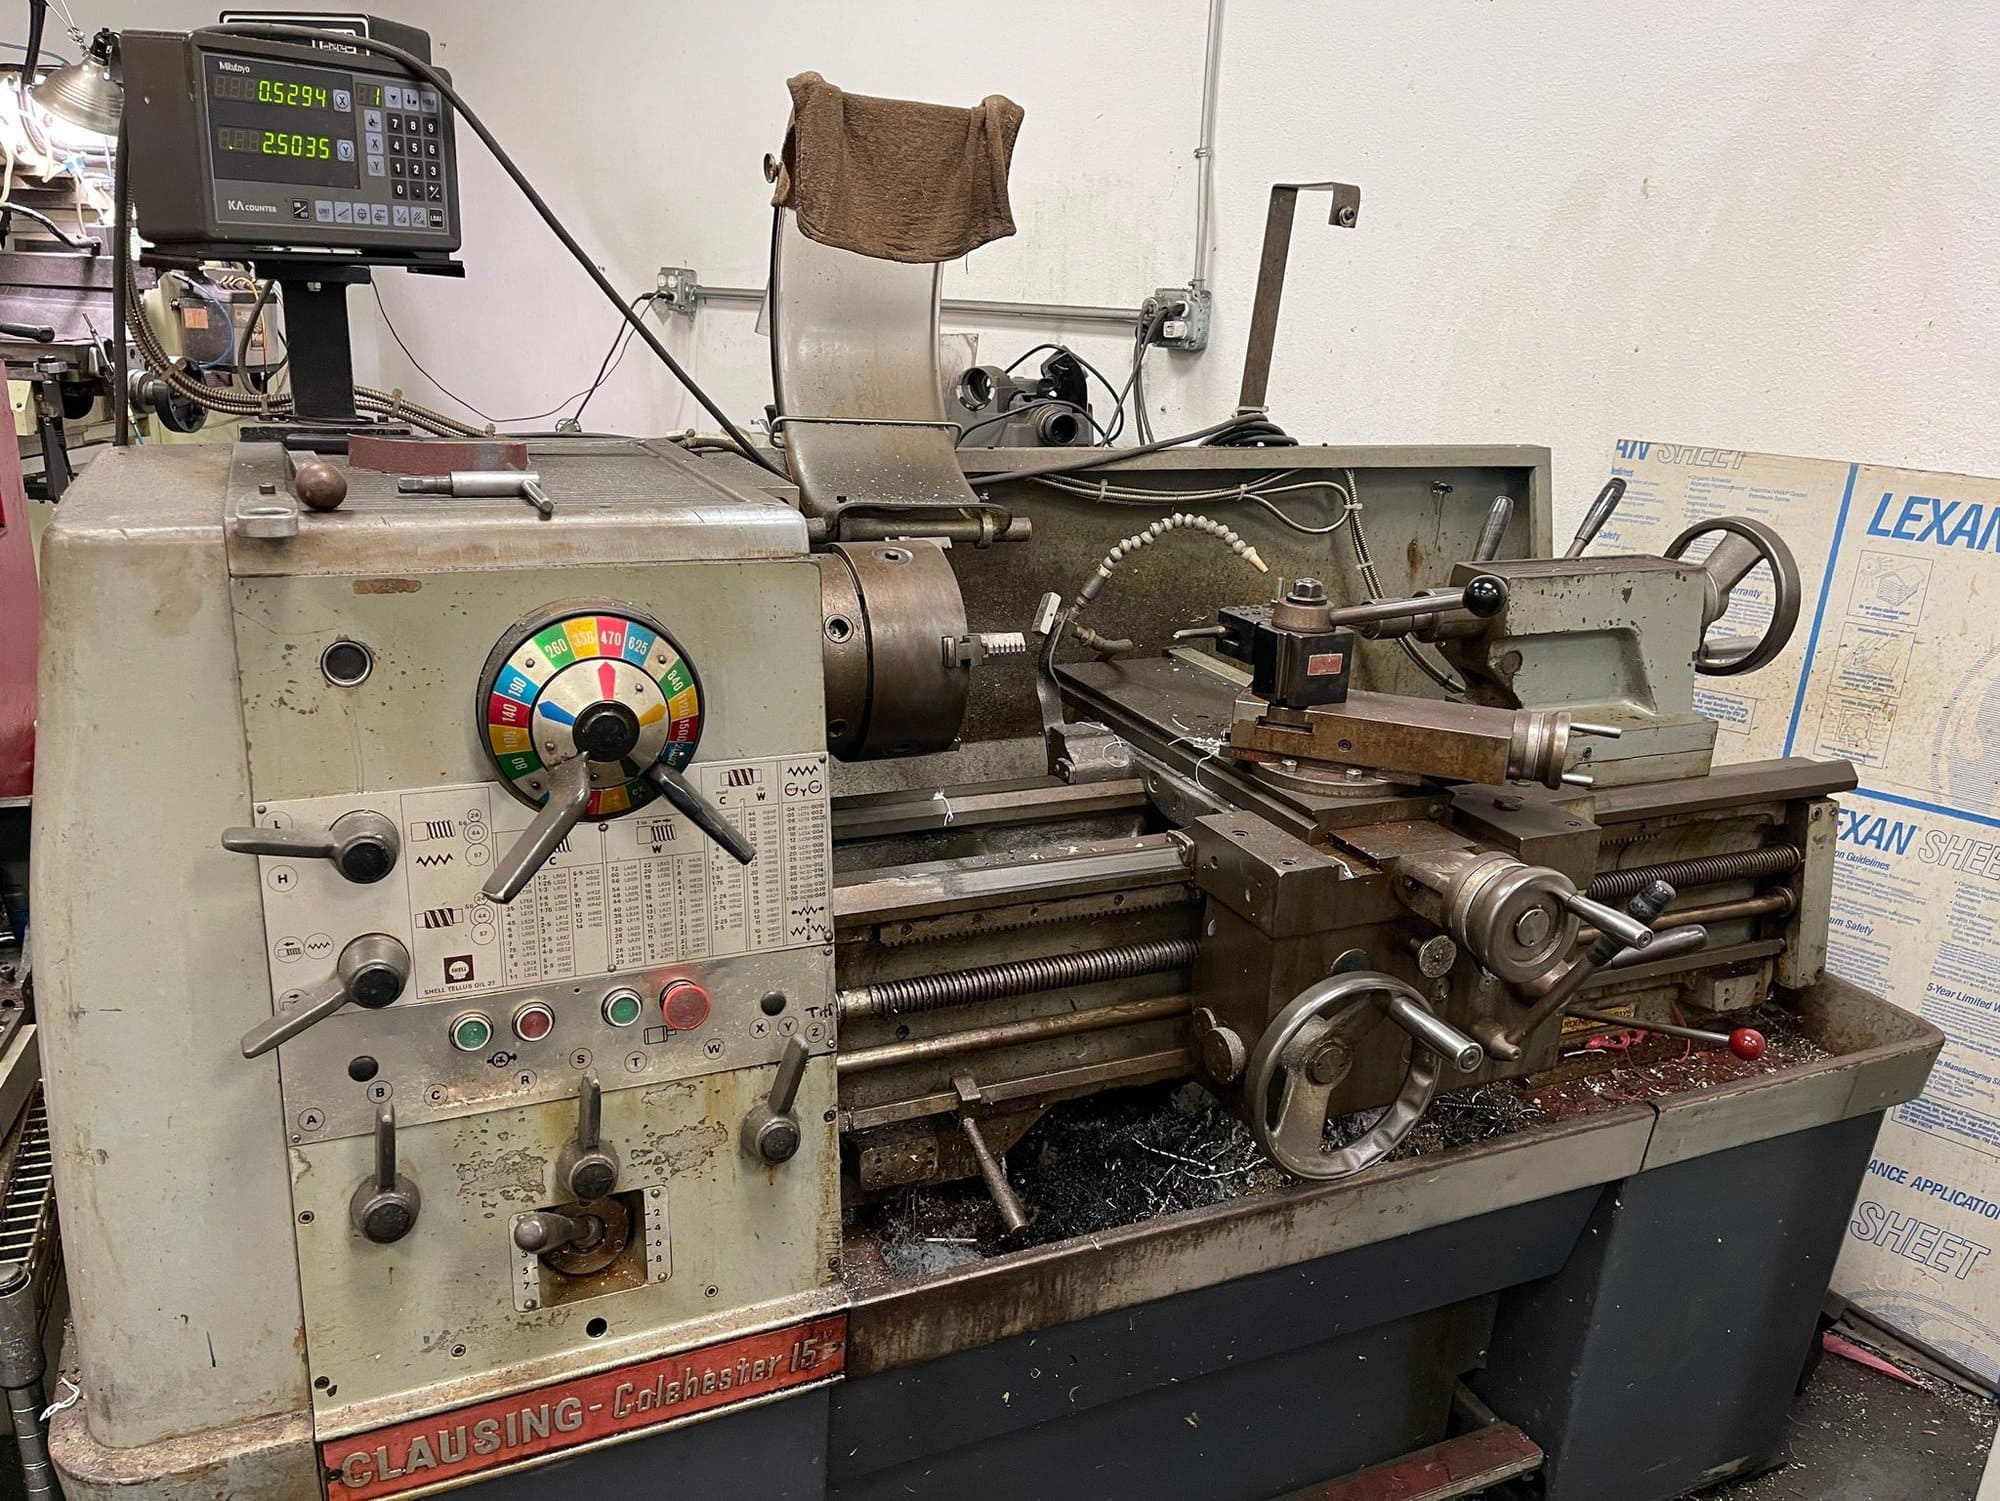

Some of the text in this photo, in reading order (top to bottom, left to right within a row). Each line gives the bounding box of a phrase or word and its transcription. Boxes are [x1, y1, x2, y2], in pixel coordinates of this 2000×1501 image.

[259, 80, 326, 107] 0.5294
[376, 88, 380, 105] 1
[392, 118, 398, 129] 7
[410, 121, 416, 131] 8
[428, 123, 434, 133] 9
[262, 132, 329, 158] 2.5035
[372, 138, 378, 148] X
[393, 141, 399, 150] 4
[412, 143, 418, 153] 5
[429, 145, 435, 155] 6
[373, 161, 379, 171] Y
[413, 165, 419, 175] 2
[430, 166, 436, 176] 3
[397, 185, 403, 194] 0
[228, 201, 277, 214] KA COUNTER
[1731, 587, 1762, 599] arranty
[600, 630, 622, 646] 470
[545, 639, 568, 658] 260
[628, 636, 649, 655] 625
[667, 670, 684, 692] 840
[508, 677, 527, 697] 190
[502, 703, 517, 722] 140
[512, 757, 528, 770] 80
[756, 792, 765, 801] W
[800, 788, 807, 796] Y
[719, 796, 726, 804] C
[274, 820, 281, 829] L
[652, 845, 662, 853] W
[1837, 808, 2000, 881] EXAN SHEE
[549, 857, 557, 865] C
[1846, 851, 1891, 871] Guidelines
[277, 874, 288, 884] H
[1845, 919, 1874, 936] Safety
[448, 984, 473, 992] TELLUS
[1926, 982, 1956, 998] 5-Year
[1956, 991, 1993, 1010] Limited
[756, 1024, 765, 1033] X
[784, 1022, 793, 1031] Y
[812, 1028, 819, 1037] Z
[707, 1045, 721, 1054] W
[576, 1054, 585, 1064] S
[632, 1057, 640, 1067] T
[520, 1075, 530, 1085] R
[375, 1087, 384, 1097] B
[431, 1090, 440, 1099] C
[306, 1114, 317, 1124] A
[1868, 1158, 1909, 1185] ANCE
[656, 1239, 662, 1247] 6
[1850, 1200, 1992, 1280] SHEET
[656, 1255, 662, 1263] 8
[522, 1266, 529, 1275] 5
[523, 1281, 530, 1290] 7
[341, 1397, 583, 1488] CLAUSING
[612, 1353, 784, 1420] Colchester
